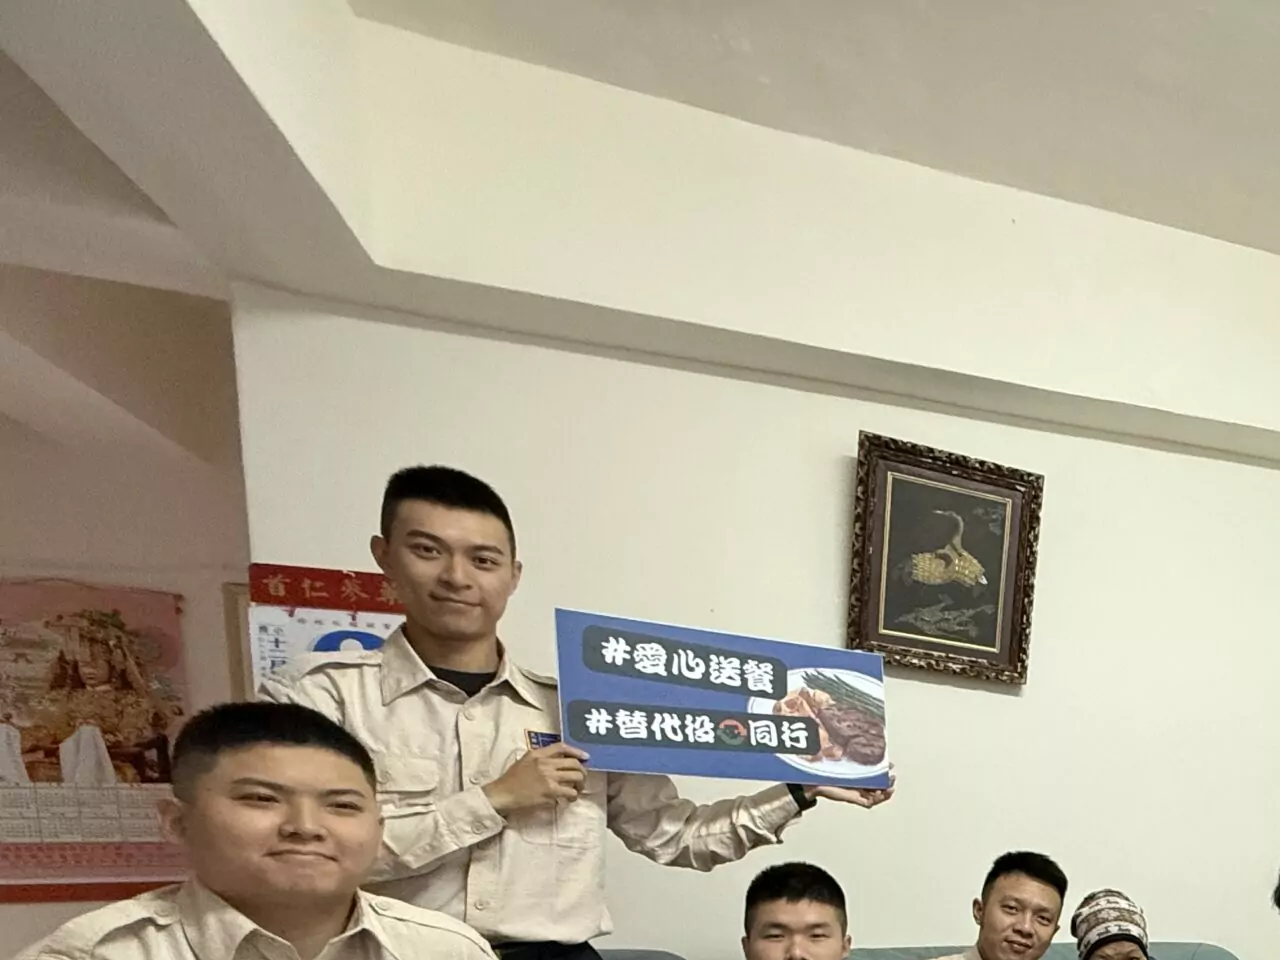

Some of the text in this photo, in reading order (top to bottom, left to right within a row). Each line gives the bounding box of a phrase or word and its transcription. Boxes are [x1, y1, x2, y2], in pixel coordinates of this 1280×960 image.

[601, 636, 775, 695] #愛心送餐
[584, 708, 716, 745] #替代役
[748, 719, 809, 749] 同行
